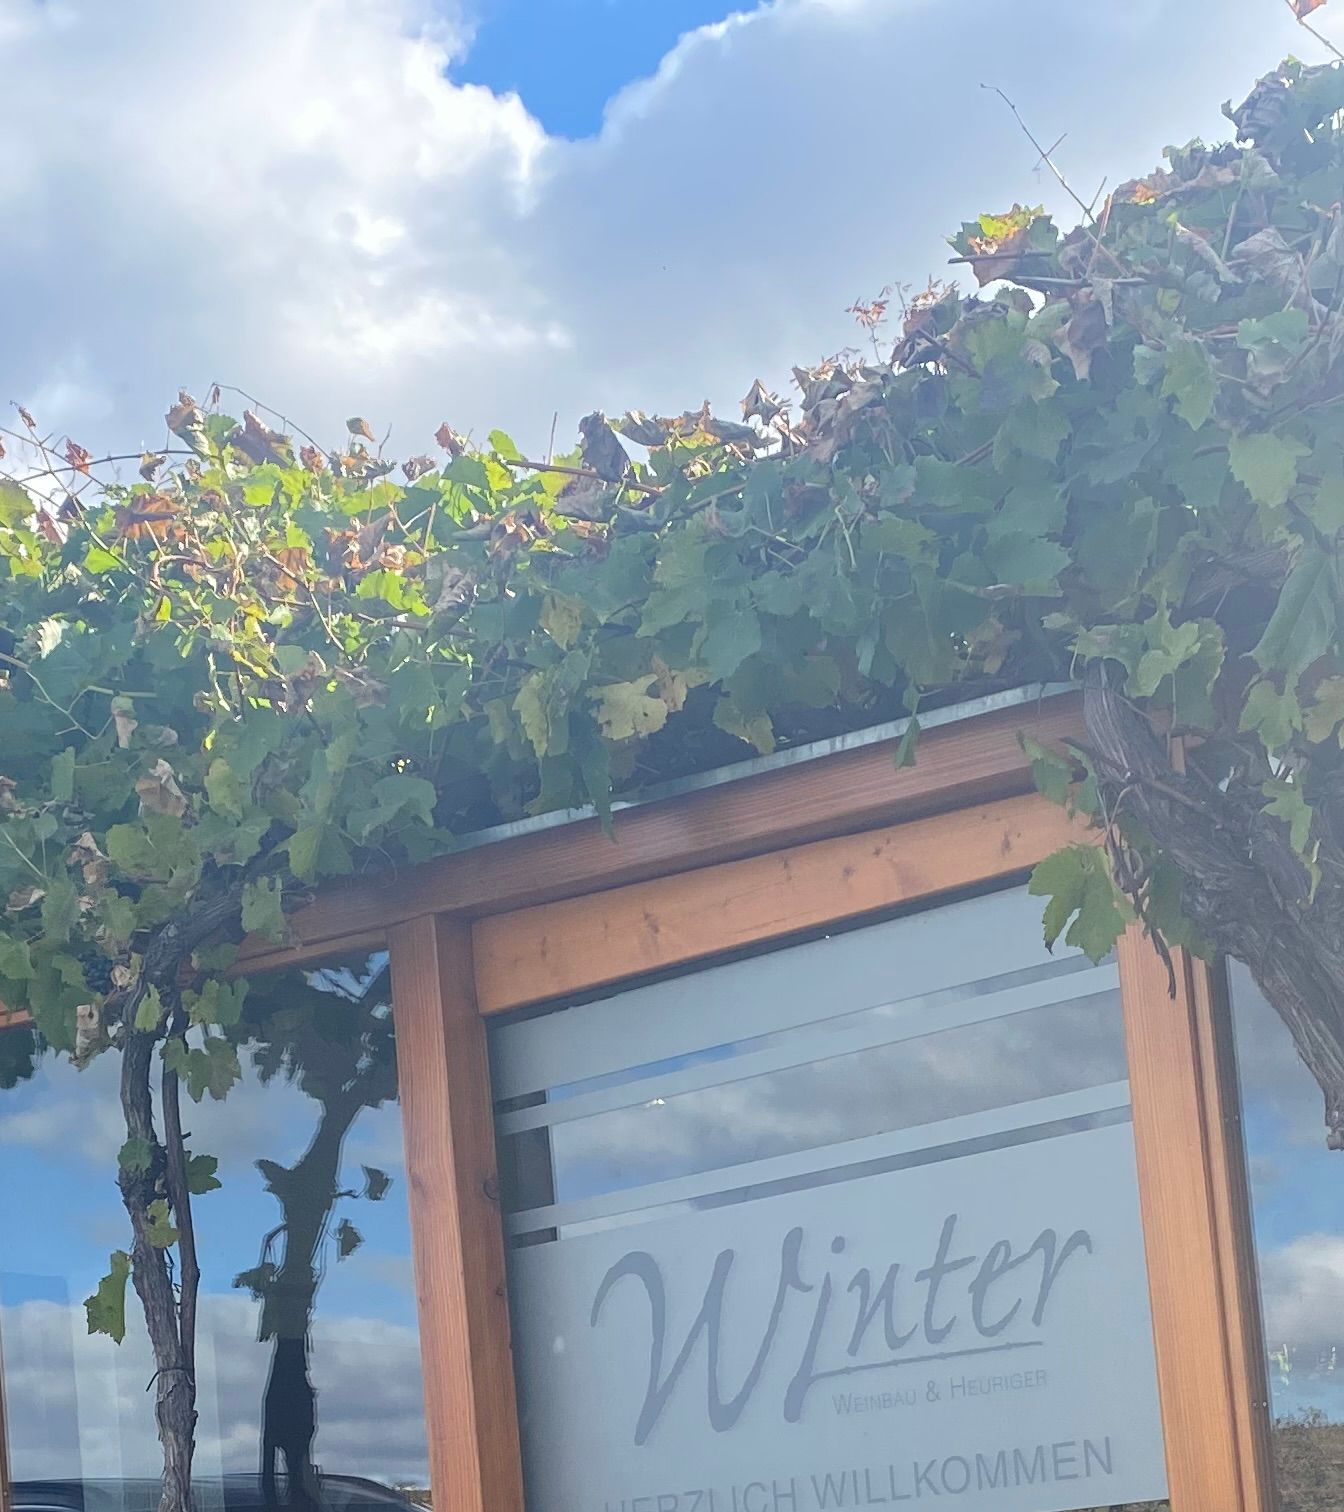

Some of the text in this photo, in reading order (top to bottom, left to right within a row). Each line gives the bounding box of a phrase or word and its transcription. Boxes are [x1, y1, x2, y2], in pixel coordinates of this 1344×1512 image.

[590, 1213, 1094, 1447] Winter
[925, 1380, 940, 1402] &
[810, 1436, 1115, 1510] WILLKOMMEN
